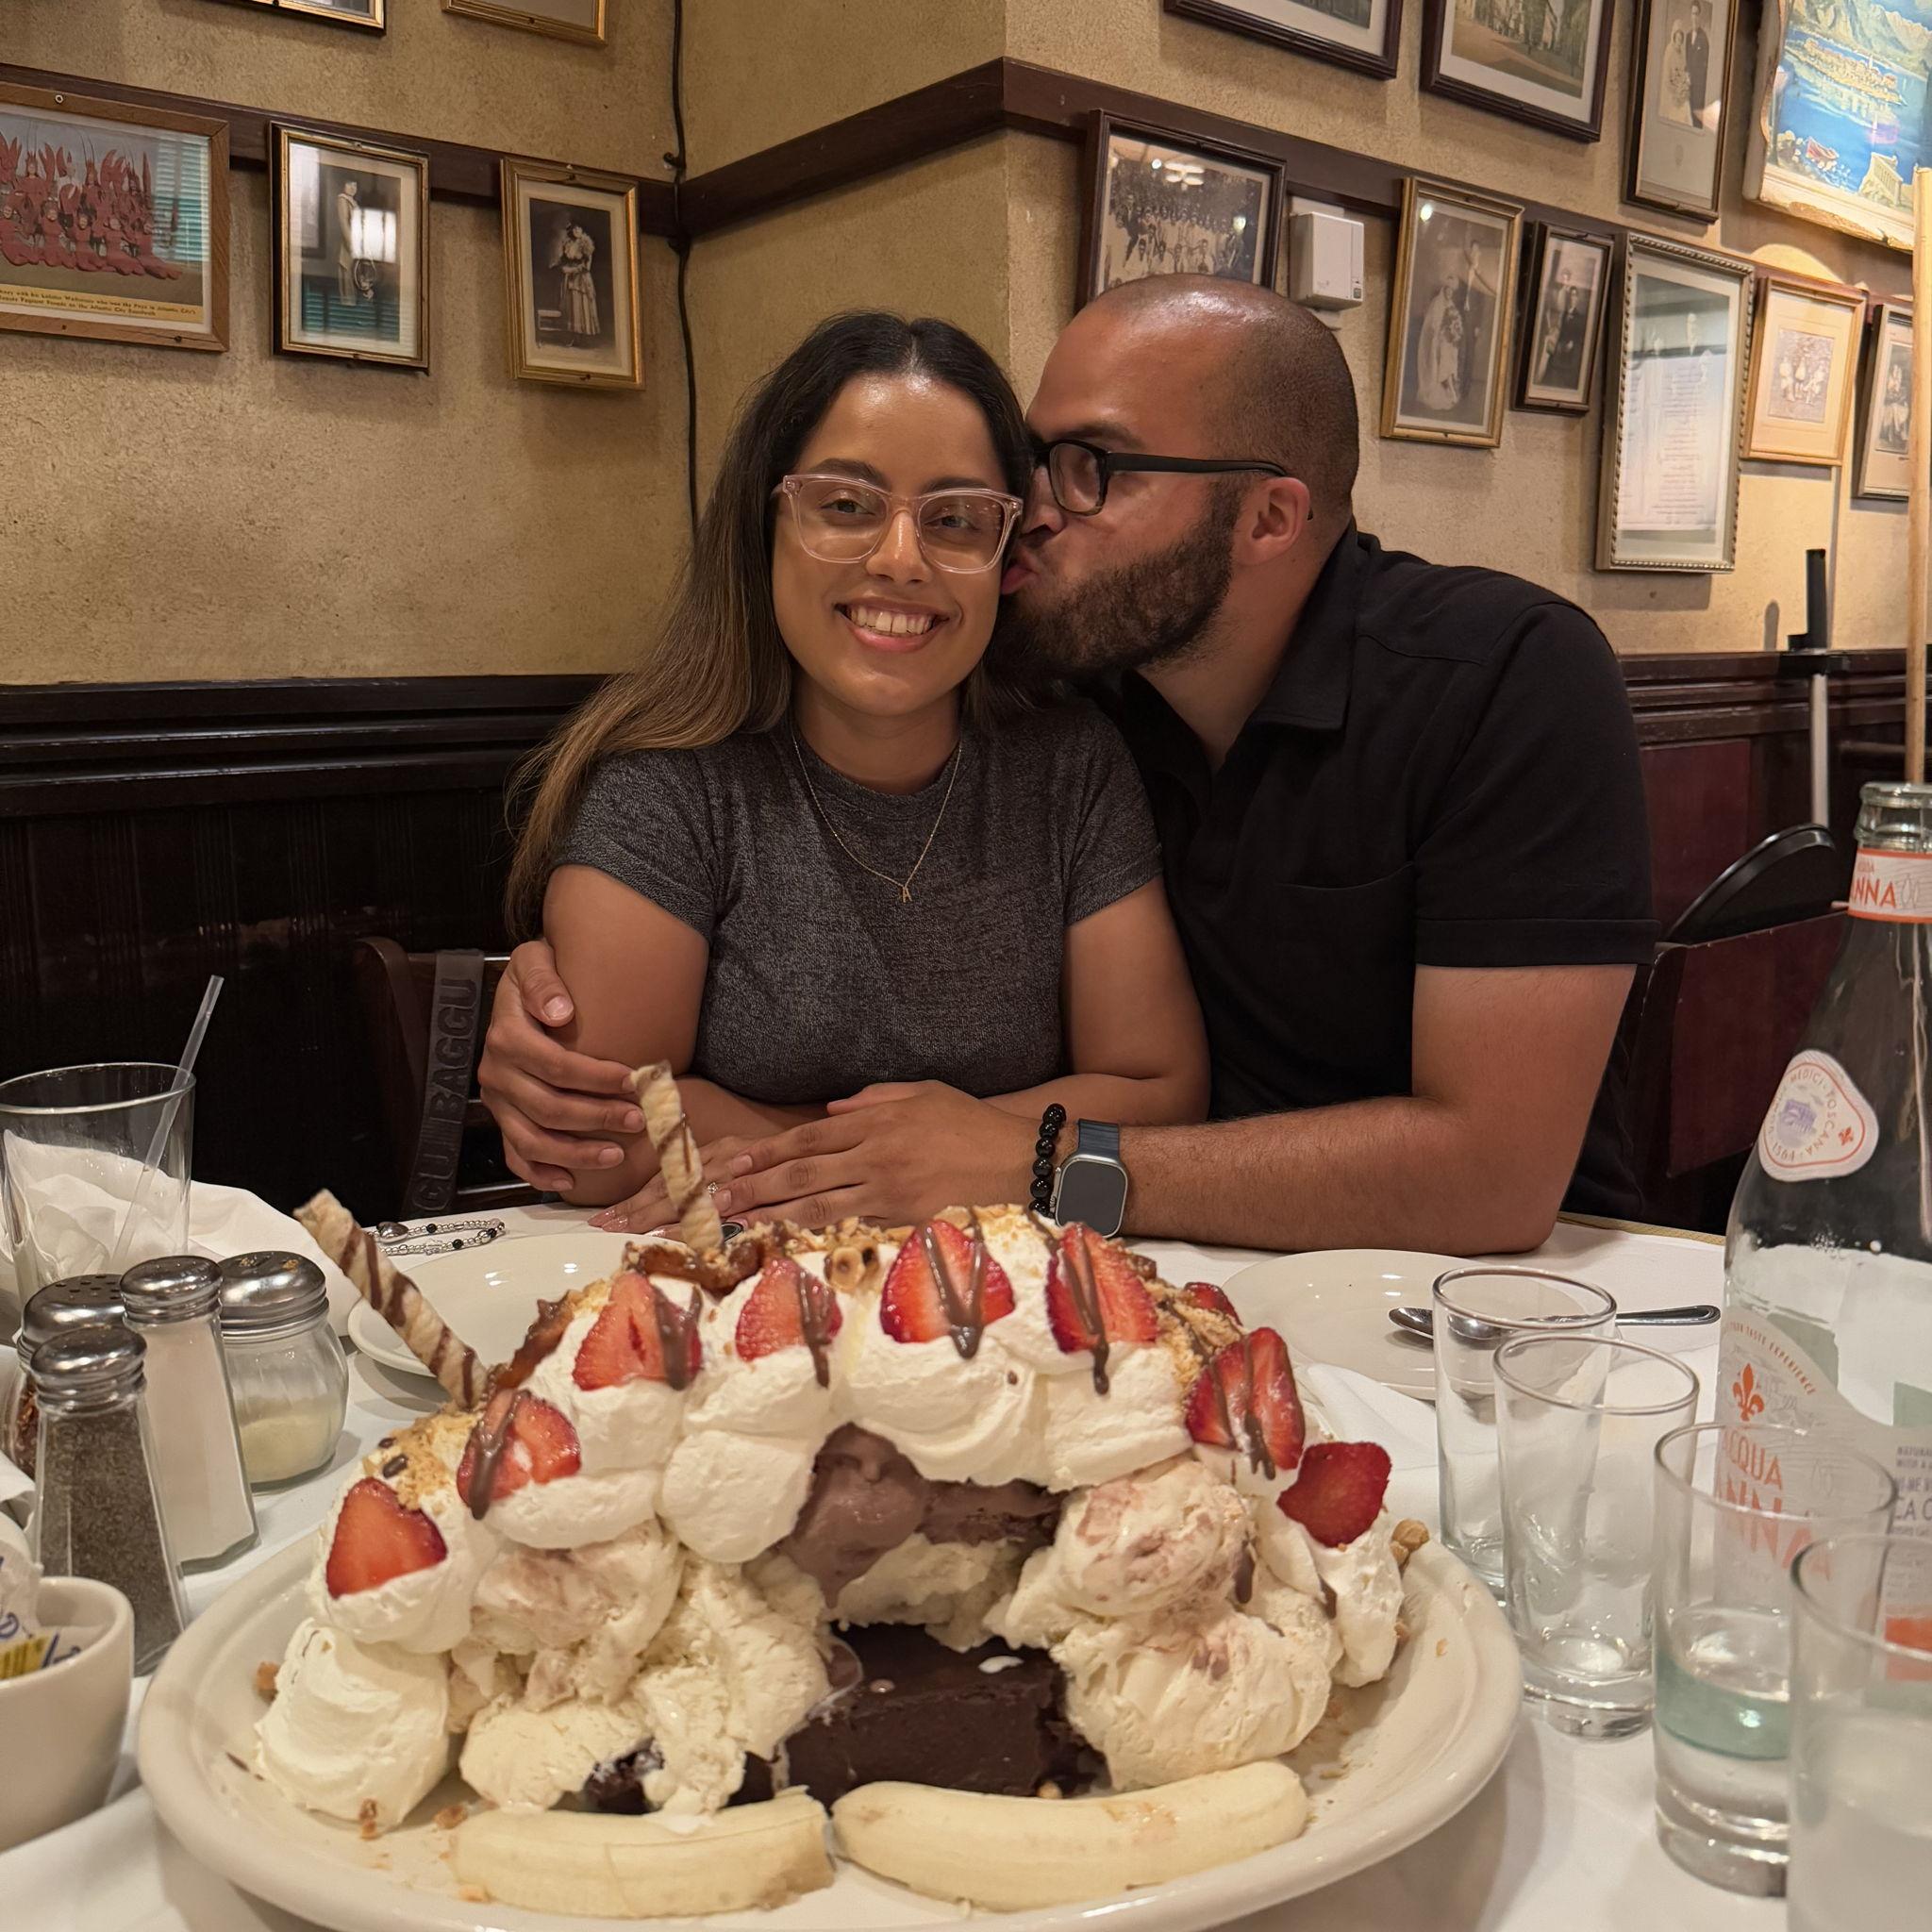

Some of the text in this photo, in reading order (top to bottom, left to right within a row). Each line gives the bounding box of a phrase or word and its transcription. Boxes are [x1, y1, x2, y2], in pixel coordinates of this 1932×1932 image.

[429, 977, 478, 1124] BAGGU
[1806, 1089, 1838, 1156] TOSCANA
[1769, 1341, 1817, 1394] EXPERIENCE
